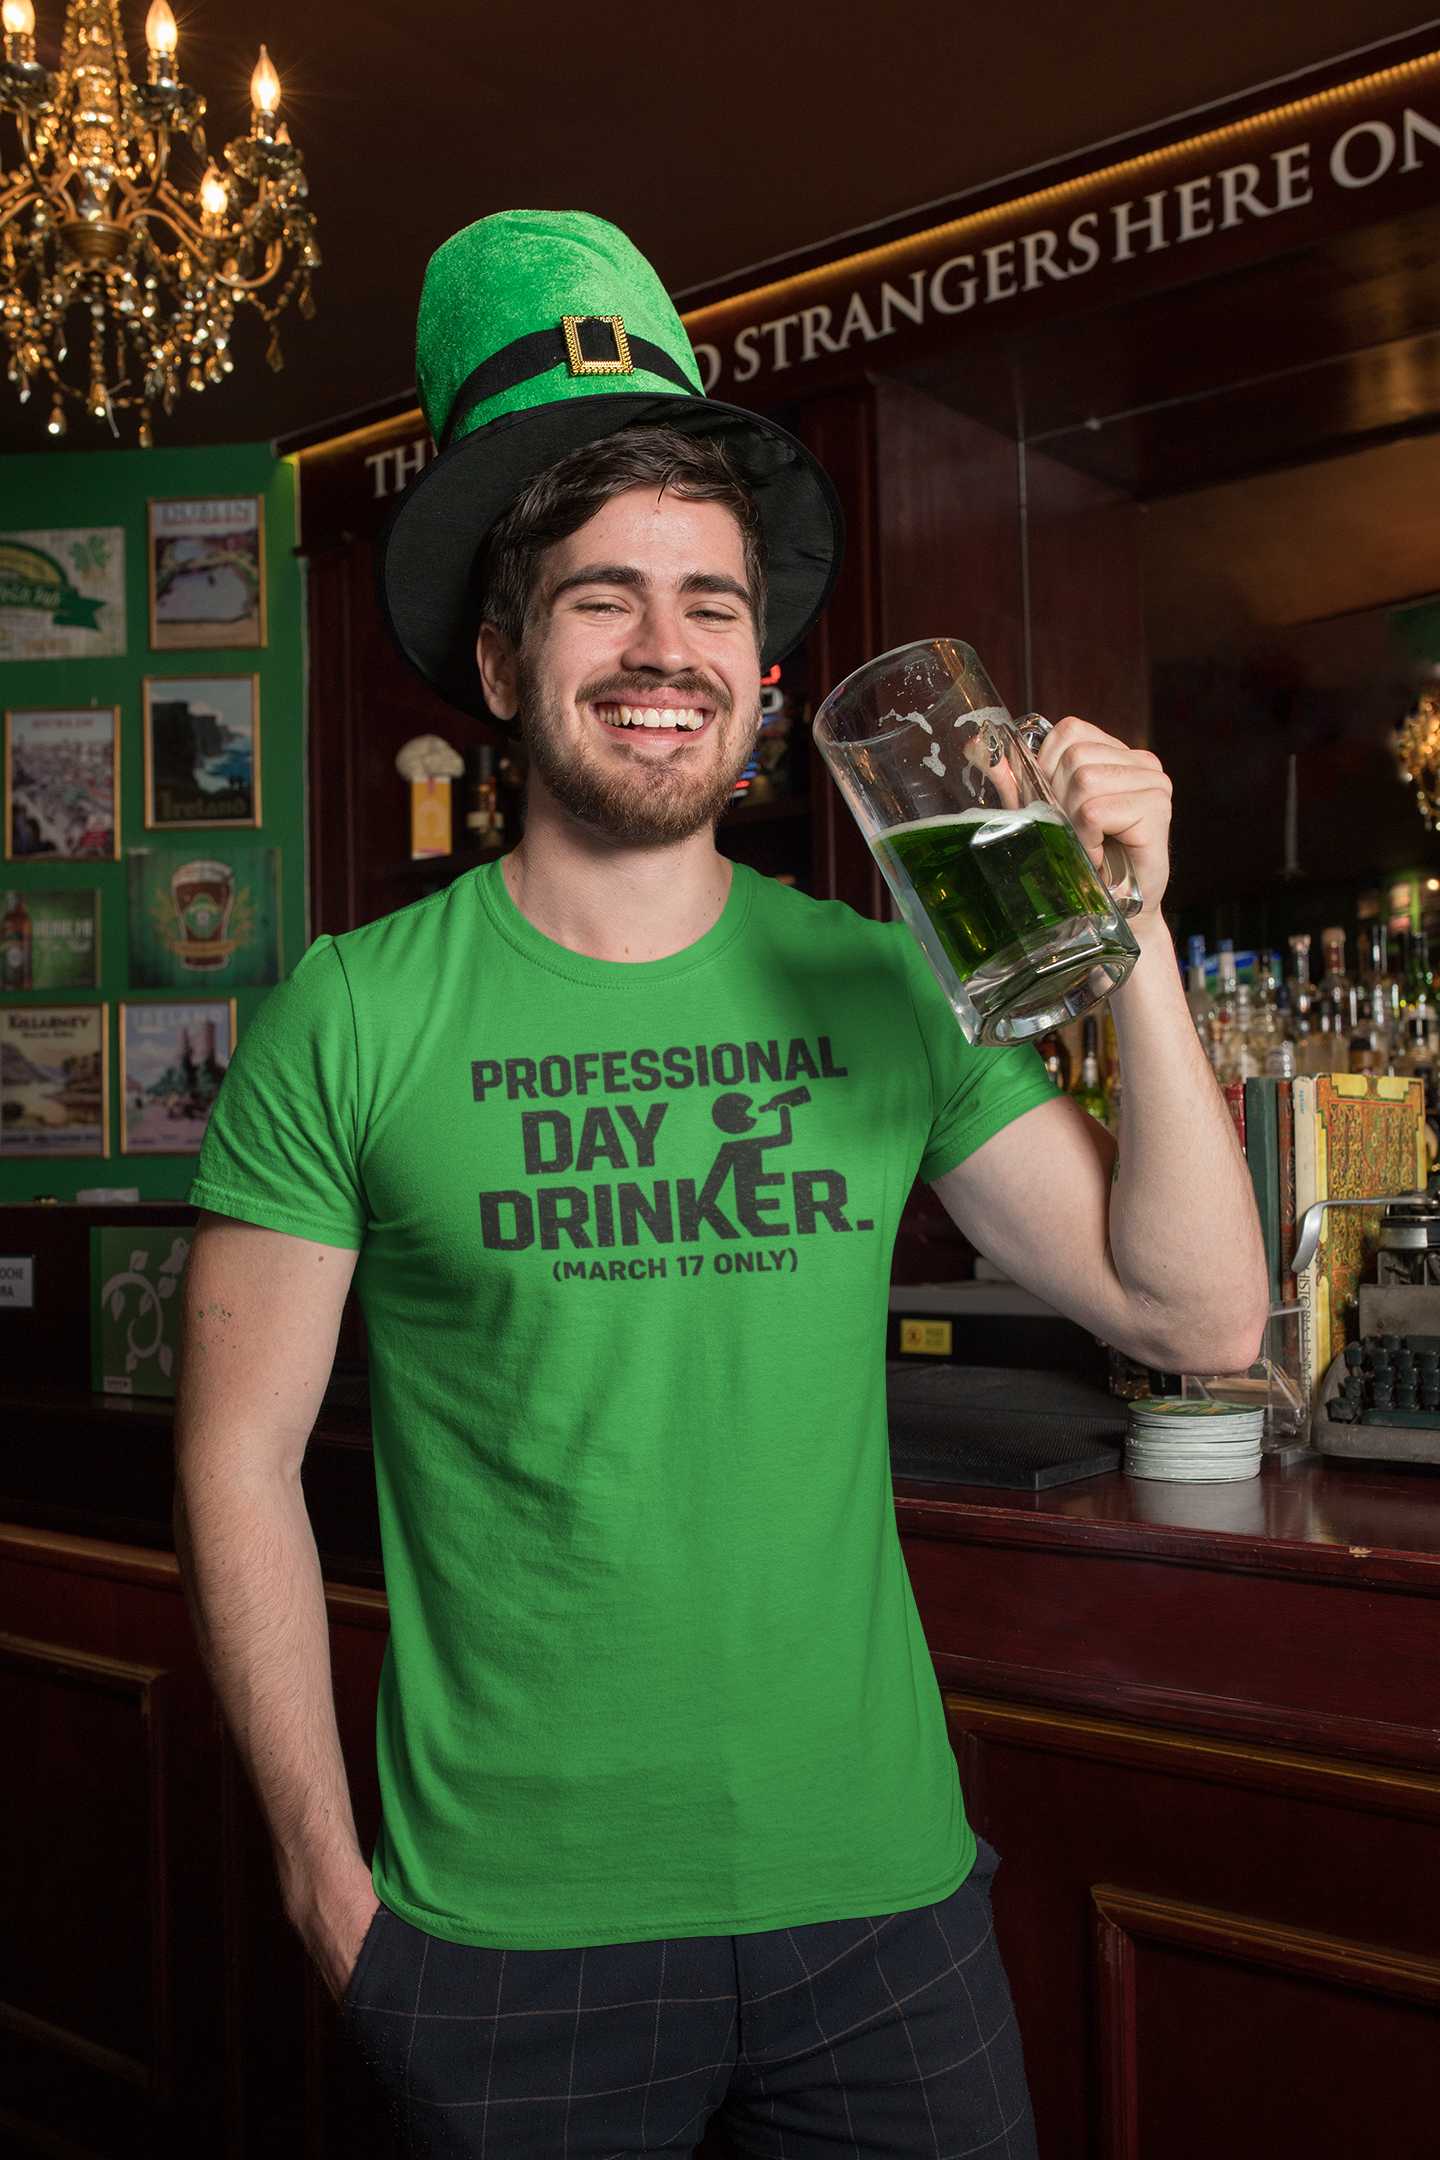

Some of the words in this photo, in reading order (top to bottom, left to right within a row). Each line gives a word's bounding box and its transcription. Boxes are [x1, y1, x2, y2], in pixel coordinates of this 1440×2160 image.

[735, 213, 1099, 381] STRANGERS
[1114, 144, 1314, 261] HERE
[471, 1036, 848, 1102] PROFESSIONAL
[521, 1102, 669, 1175] DAY
[479, 1168, 874, 1251] DRINKER.
[552, 1256, 667, 1282] (MARCH
[676, 1255, 704, 1276] 17
[714, 1247, 798, 1274] ONLY)
